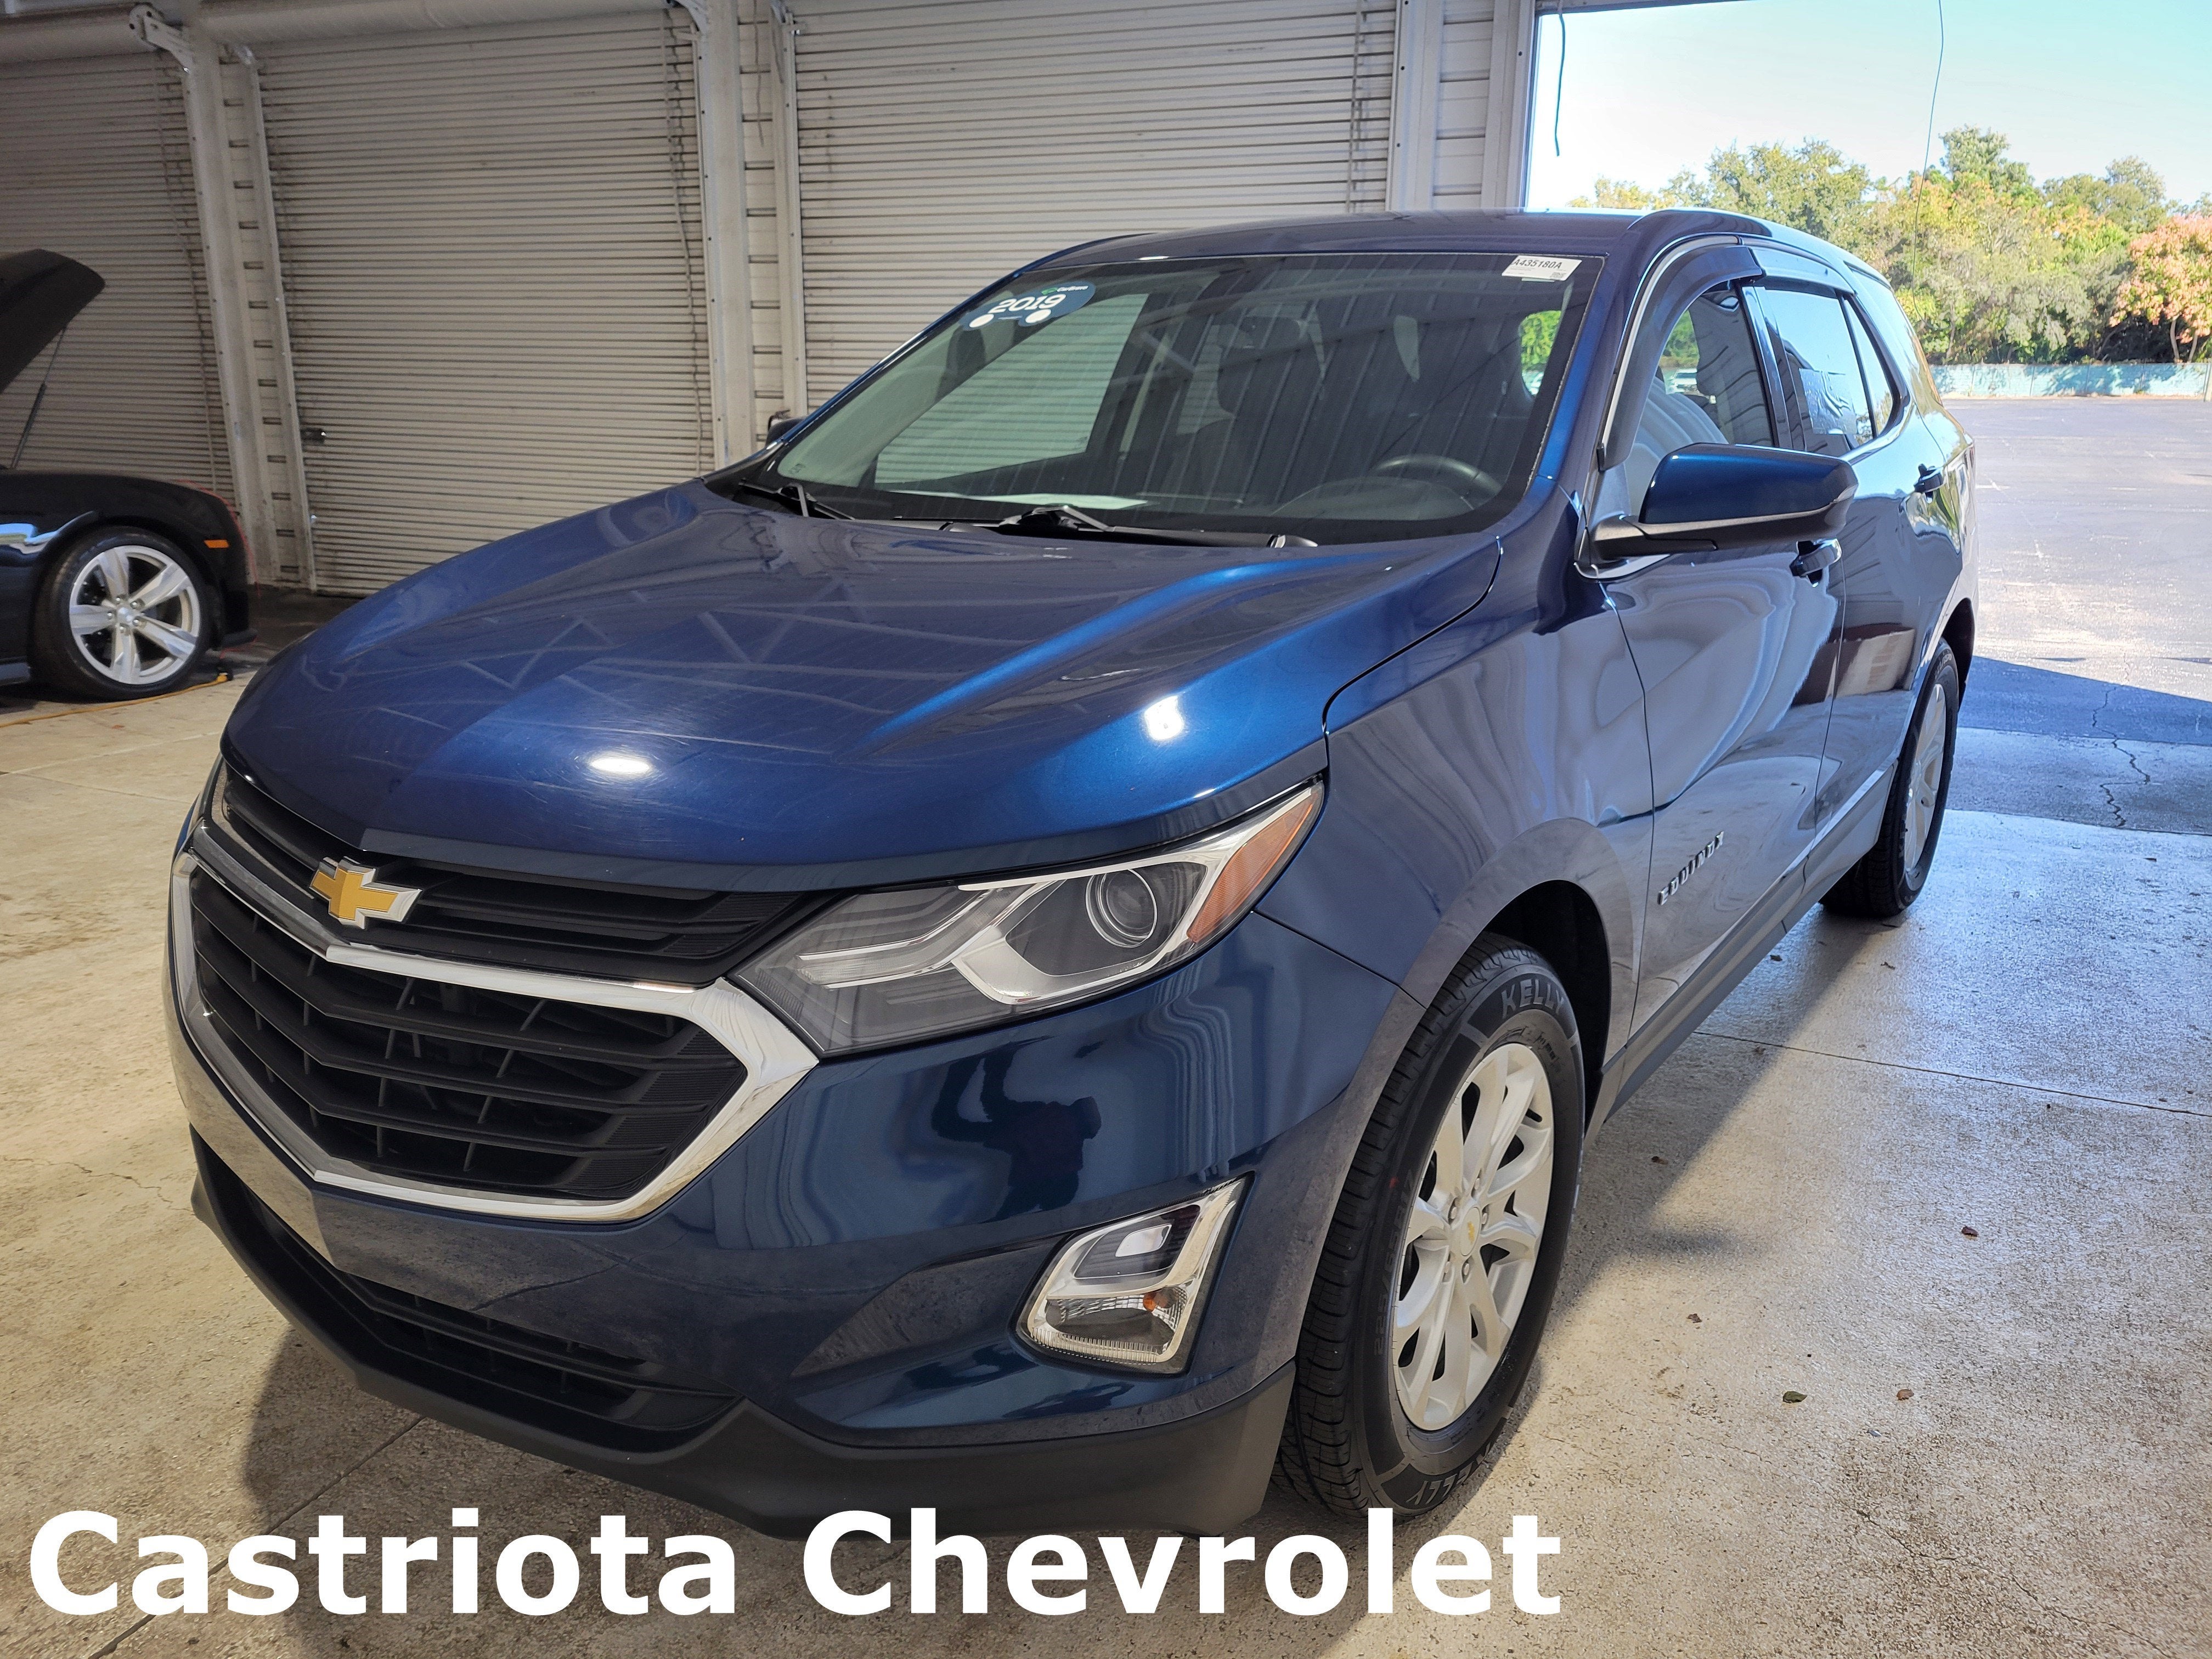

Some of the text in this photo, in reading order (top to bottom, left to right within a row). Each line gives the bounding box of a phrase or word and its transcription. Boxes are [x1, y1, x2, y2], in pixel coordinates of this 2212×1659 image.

[1512, 259, 1562, 269] A435180A
[988, 294, 1066, 314] 2019
[1657, 831, 1724, 906] EQUINOX
[1500, 979, 1564, 1019] KELLY
